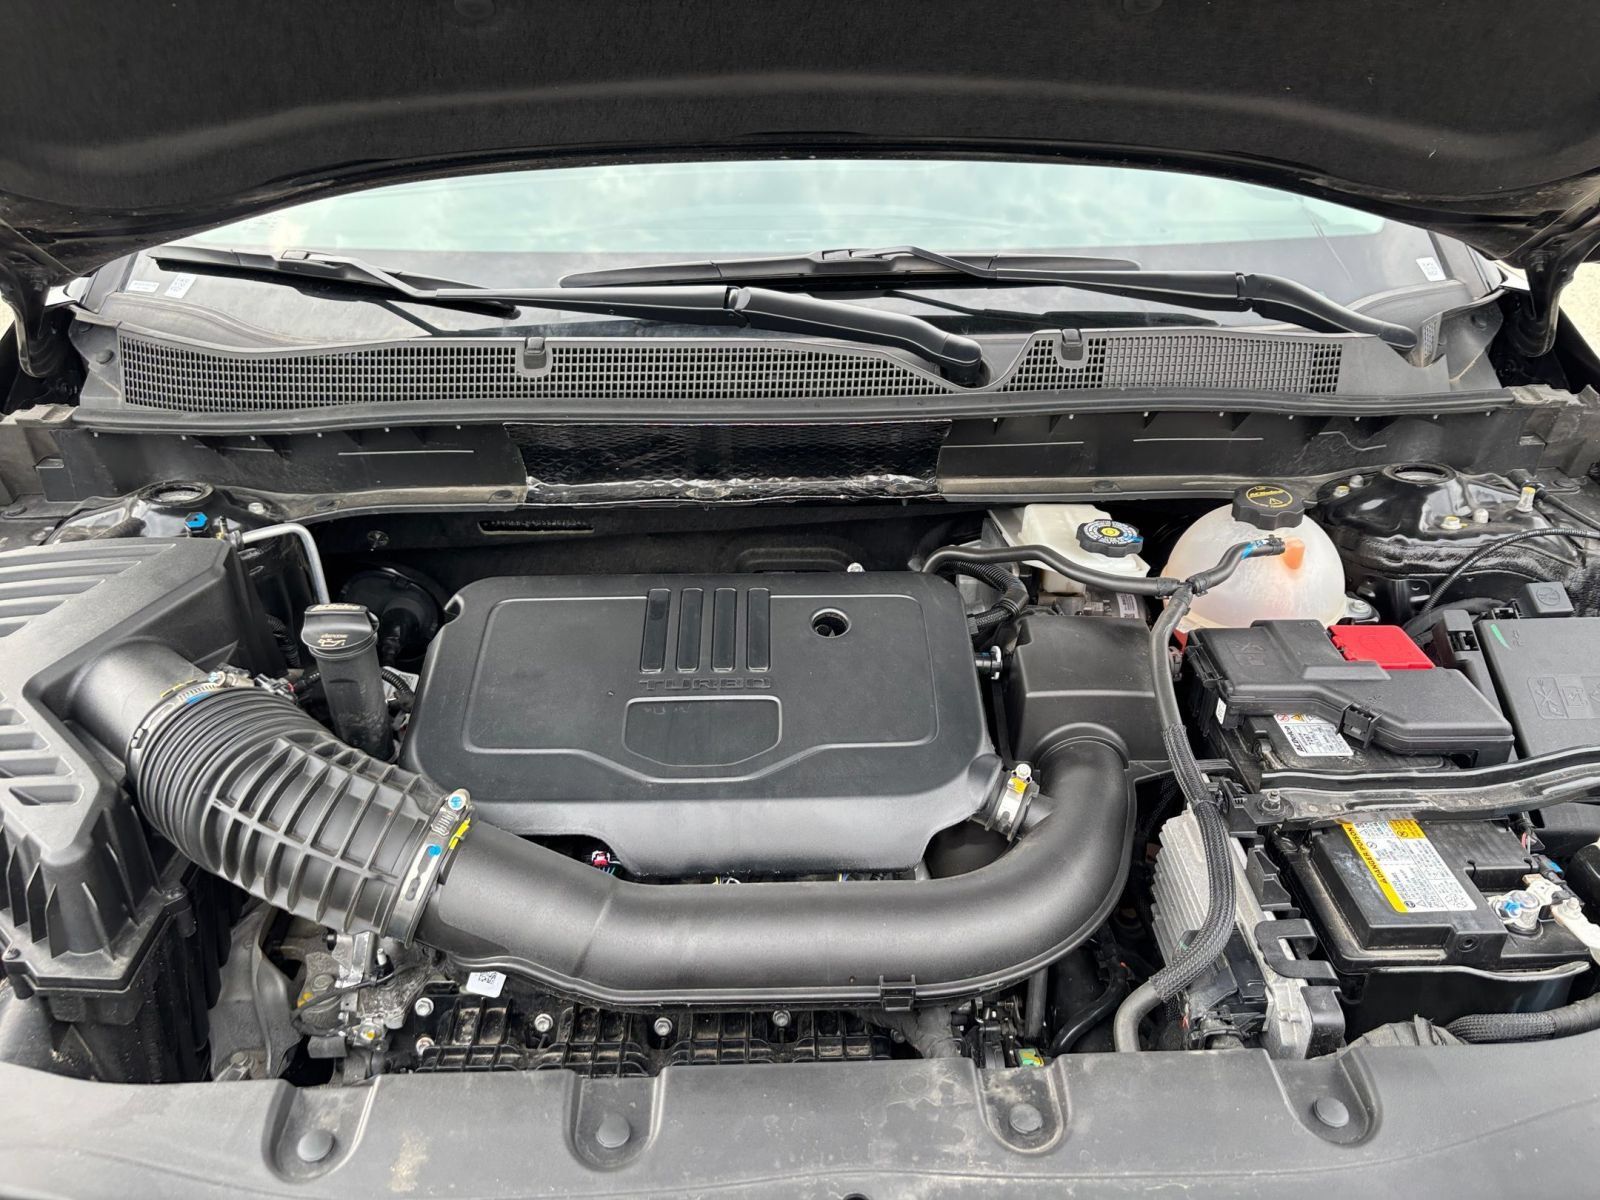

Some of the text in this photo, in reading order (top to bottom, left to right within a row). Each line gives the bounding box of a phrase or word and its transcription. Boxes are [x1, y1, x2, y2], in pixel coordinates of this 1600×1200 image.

[639, 677, 772, 690] TURBO
[1347, 827, 1385, 878] DANGER POISON
